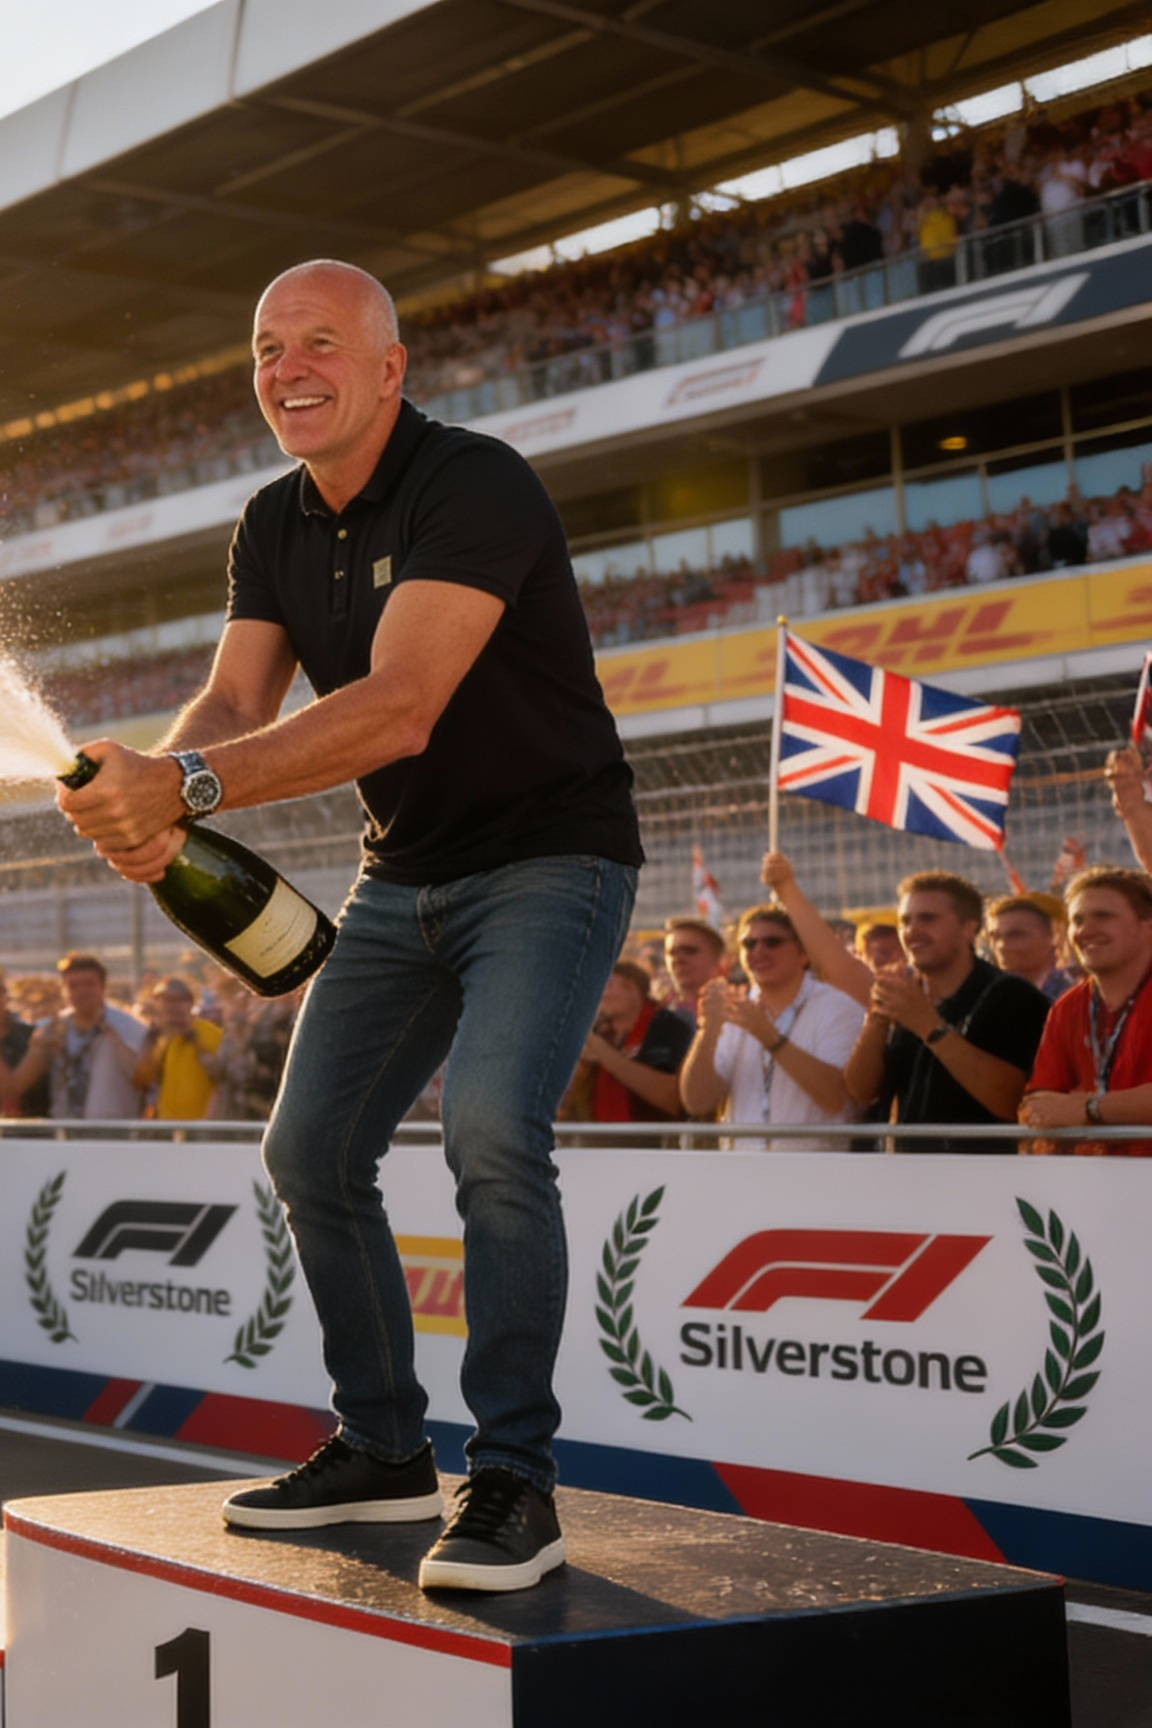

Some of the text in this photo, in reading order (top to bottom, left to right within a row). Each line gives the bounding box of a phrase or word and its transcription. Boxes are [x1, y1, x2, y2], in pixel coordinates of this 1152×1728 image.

[72, 1200, 240, 1267] F1
[70, 1268, 232, 1317] Silverstone
[680, 1228, 995, 1322] F1
[679, 1321, 988, 1394] Silverstone
[154, 1627, 211, 1728] 1
